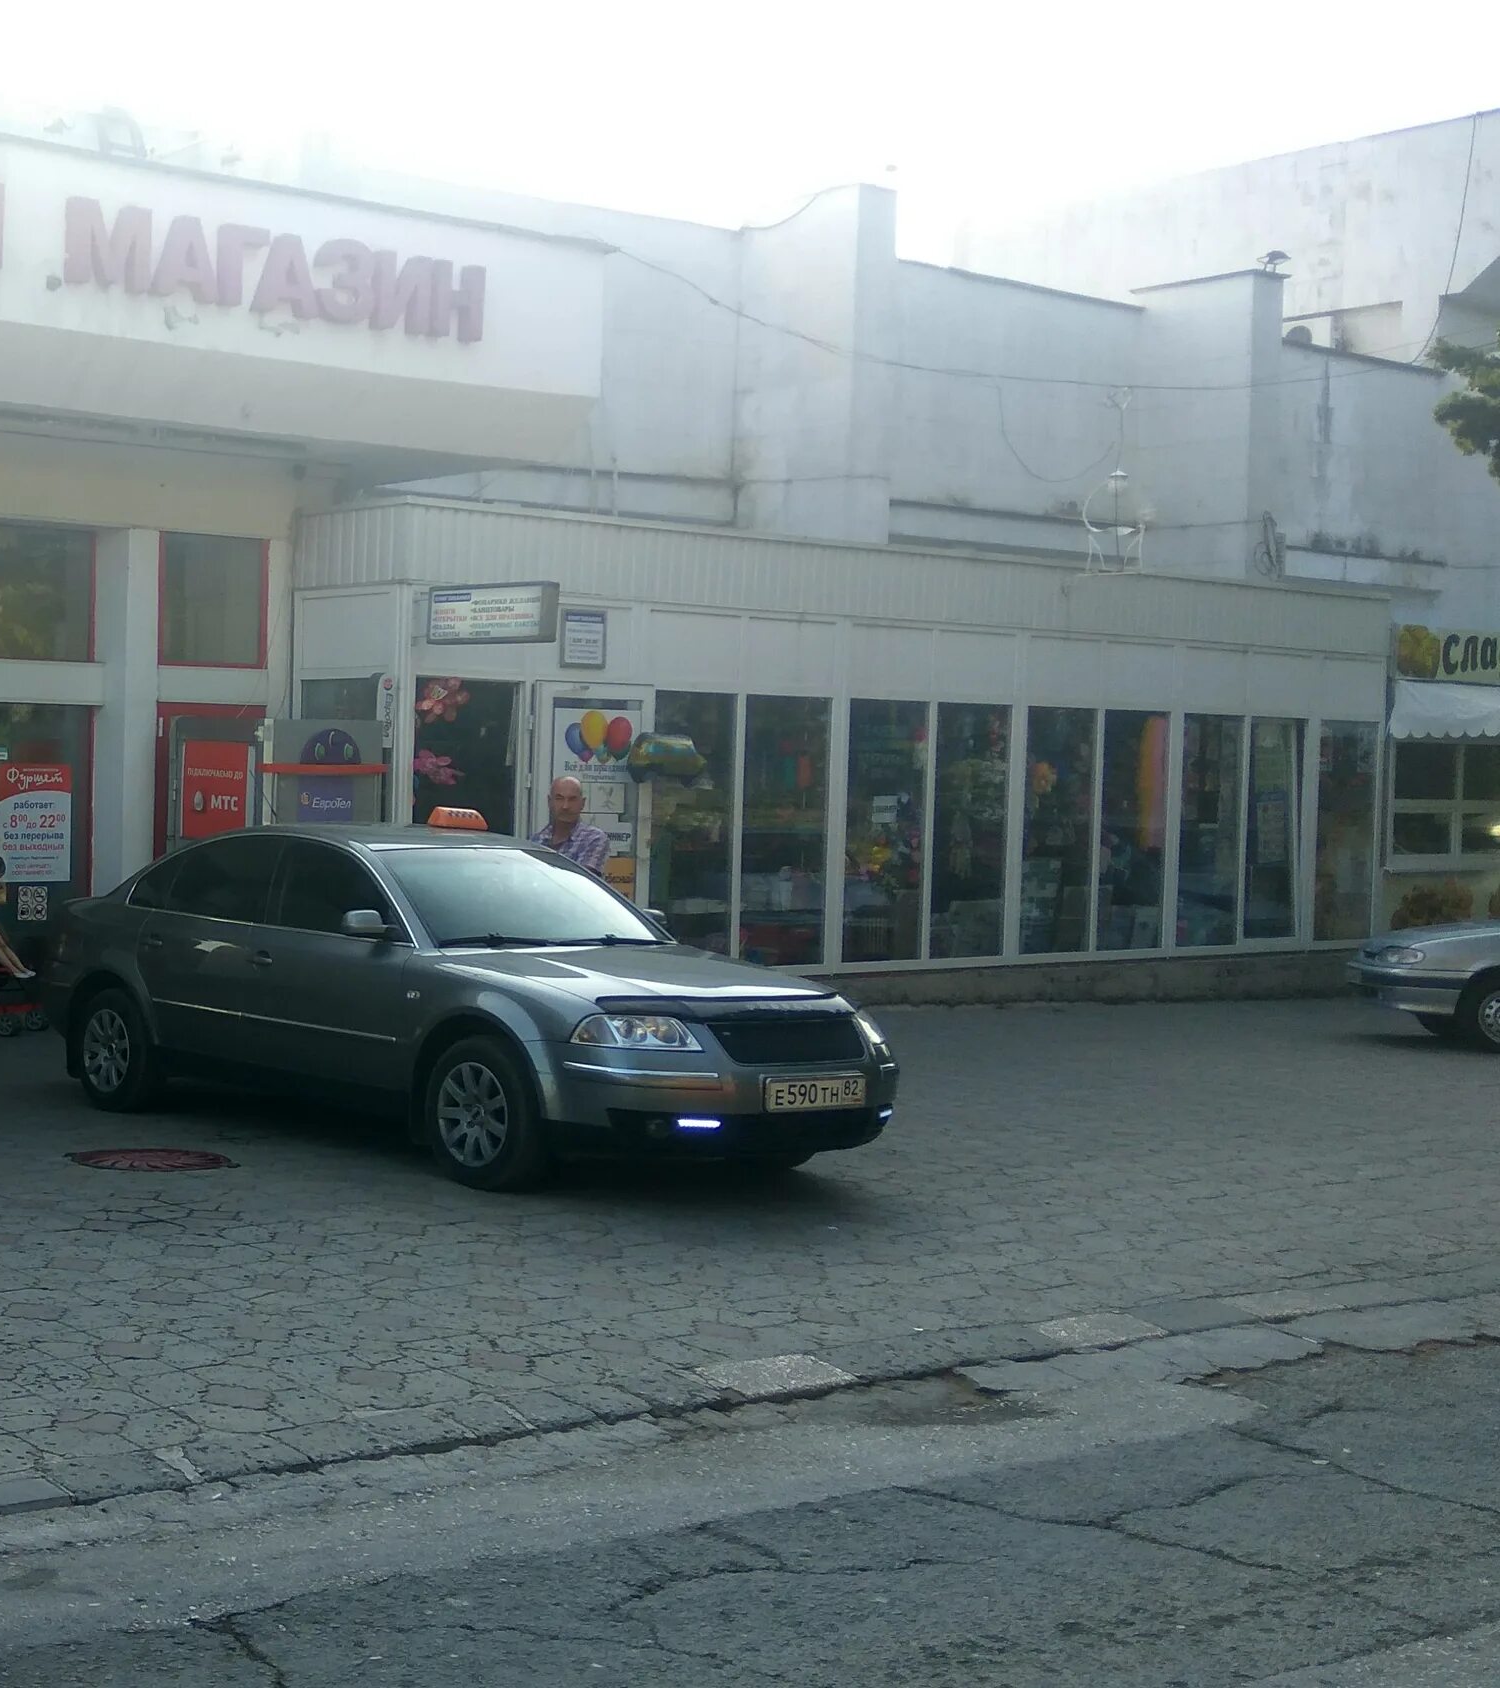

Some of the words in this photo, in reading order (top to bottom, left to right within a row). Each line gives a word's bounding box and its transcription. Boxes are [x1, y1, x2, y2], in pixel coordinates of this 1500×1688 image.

[64, 196, 486, 343] МАГАЗИН
[210, 794, 239, 811] МТС
[312, 797, 352, 811] ЕвроТел
[843, 1080, 859, 1096] 82
